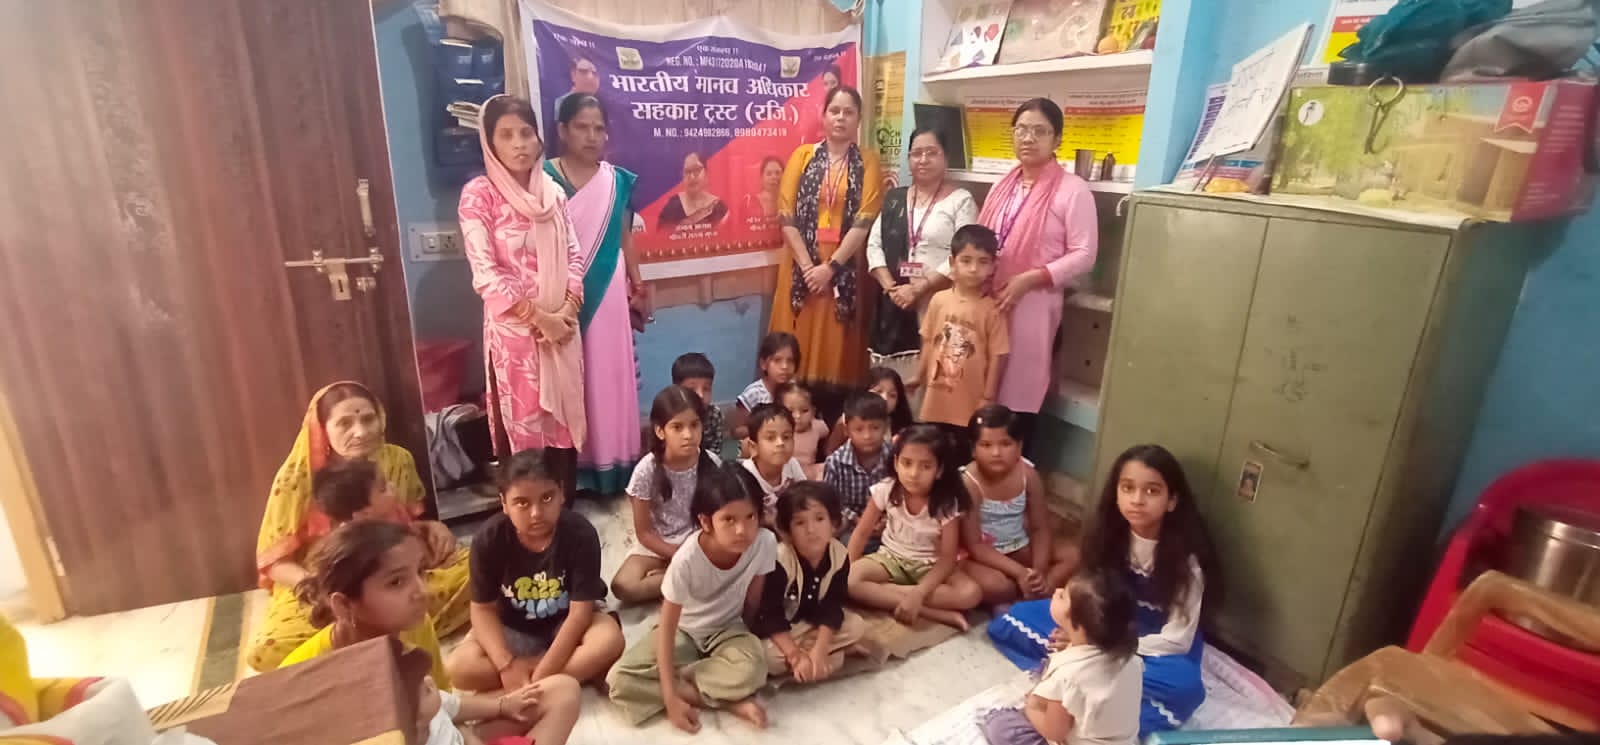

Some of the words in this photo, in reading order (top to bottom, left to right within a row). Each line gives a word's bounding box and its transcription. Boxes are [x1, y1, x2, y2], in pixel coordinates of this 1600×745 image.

[609, 71, 688, 92] भारतीय
[695, 76, 739, 94] मानव
[746, 76, 810, 97] अधिकार
[630, 101, 699, 120] सहकार
[703, 104, 738, 124] ट्रस्ट
[745, 100, 799, 125] (रजि.)
